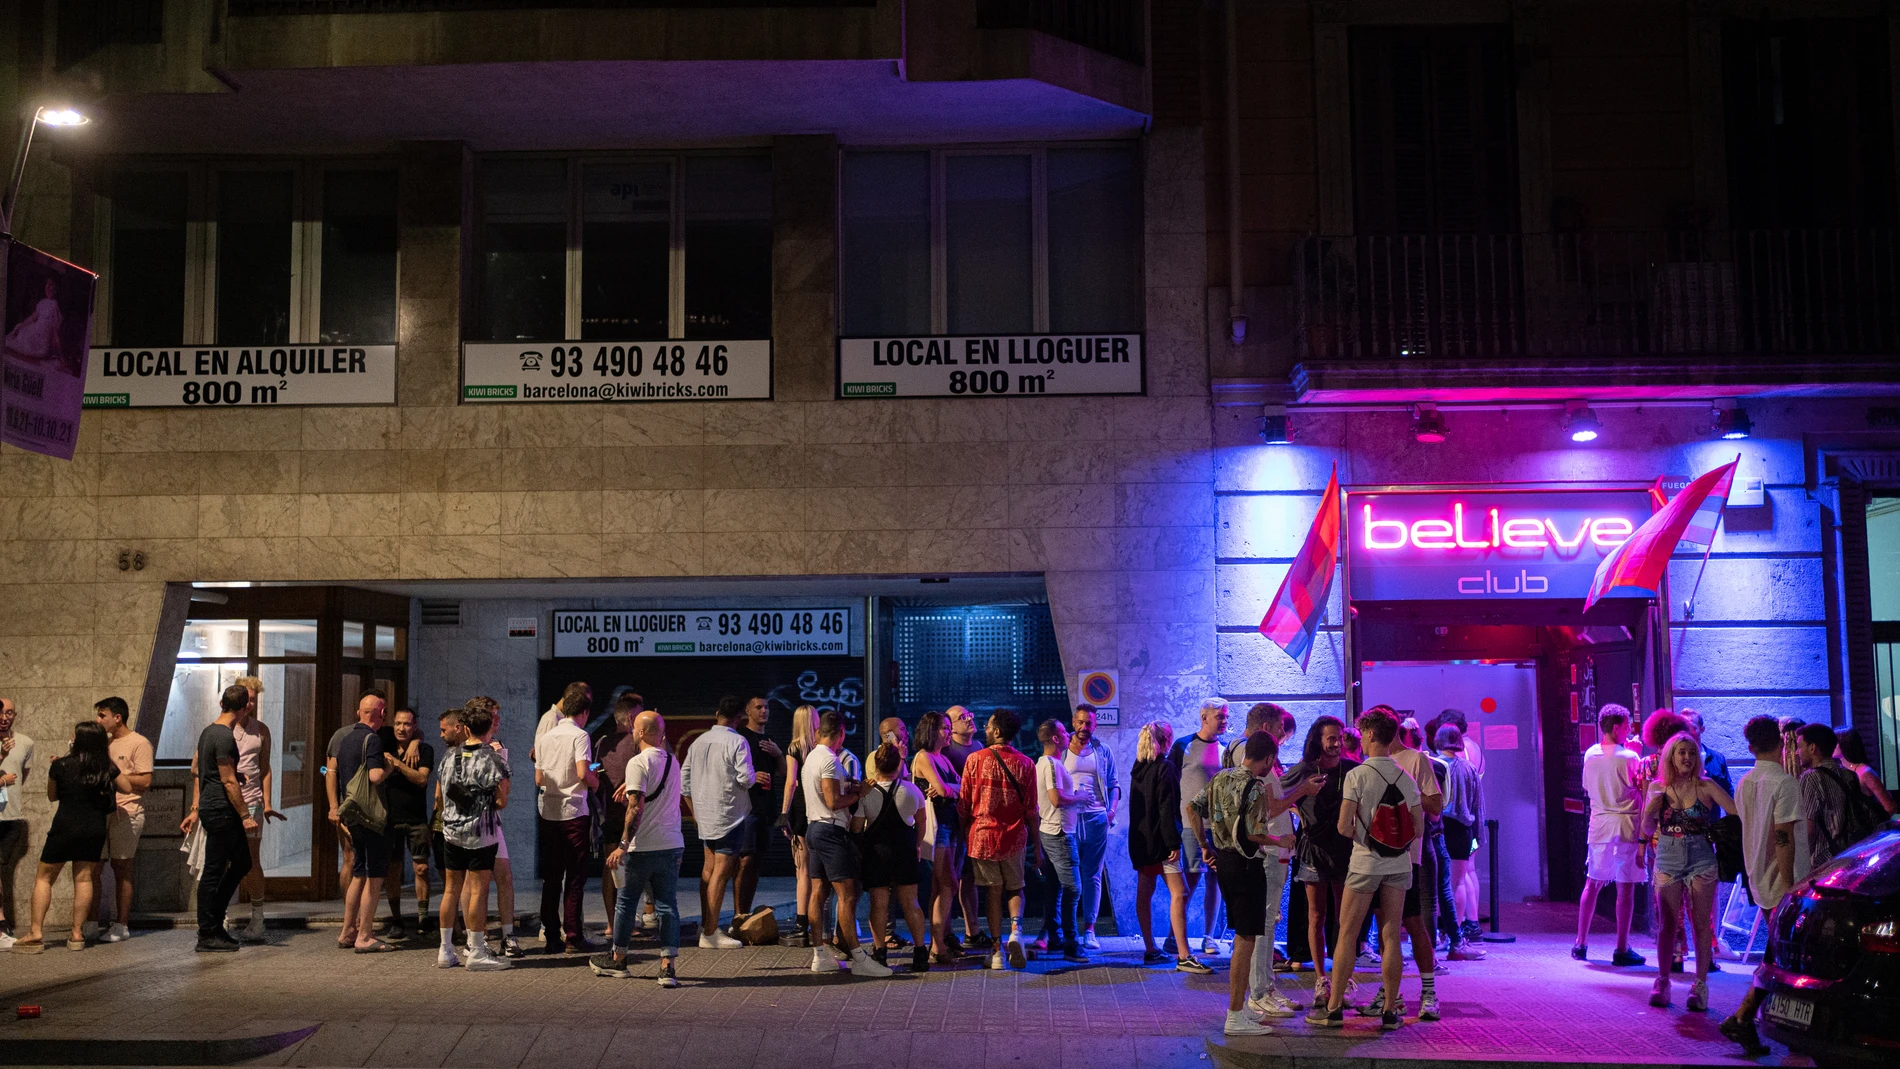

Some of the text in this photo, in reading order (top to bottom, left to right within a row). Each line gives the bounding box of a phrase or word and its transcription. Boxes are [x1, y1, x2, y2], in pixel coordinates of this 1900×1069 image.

[104, 348, 367, 377] LOCAL EN ALQUILER
[550, 345, 728, 377] 93 490 48 46
[873, 337, 1130, 365] LOCAL EN LLOGUER
[182, 380, 242, 404] 800
[467, 387, 514, 397] KIWI BRICKS
[523, 382, 729, 401] barcelona@kiwibricks.com
[847, 384, 893, 394] KIWI BRICKS
[949, 370, 1009, 394] 800
[99, 395, 127, 405] BRICKS
[119, 550, 145, 571] 58
[1457, 569, 1549, 594] club
[557, 615, 600, 633] LOCAL
[604, 615, 622, 633] EN
[625, 615, 686, 633] LLOGUER
[718, 613, 741, 635] 93
[748, 613, 783, 635] 490
[790, 613, 813, 635] 48
[820, 612, 843, 634] 46
[587, 637, 620, 653] 800
[699, 641, 844, 653] barcelona@kiwibricks.com
